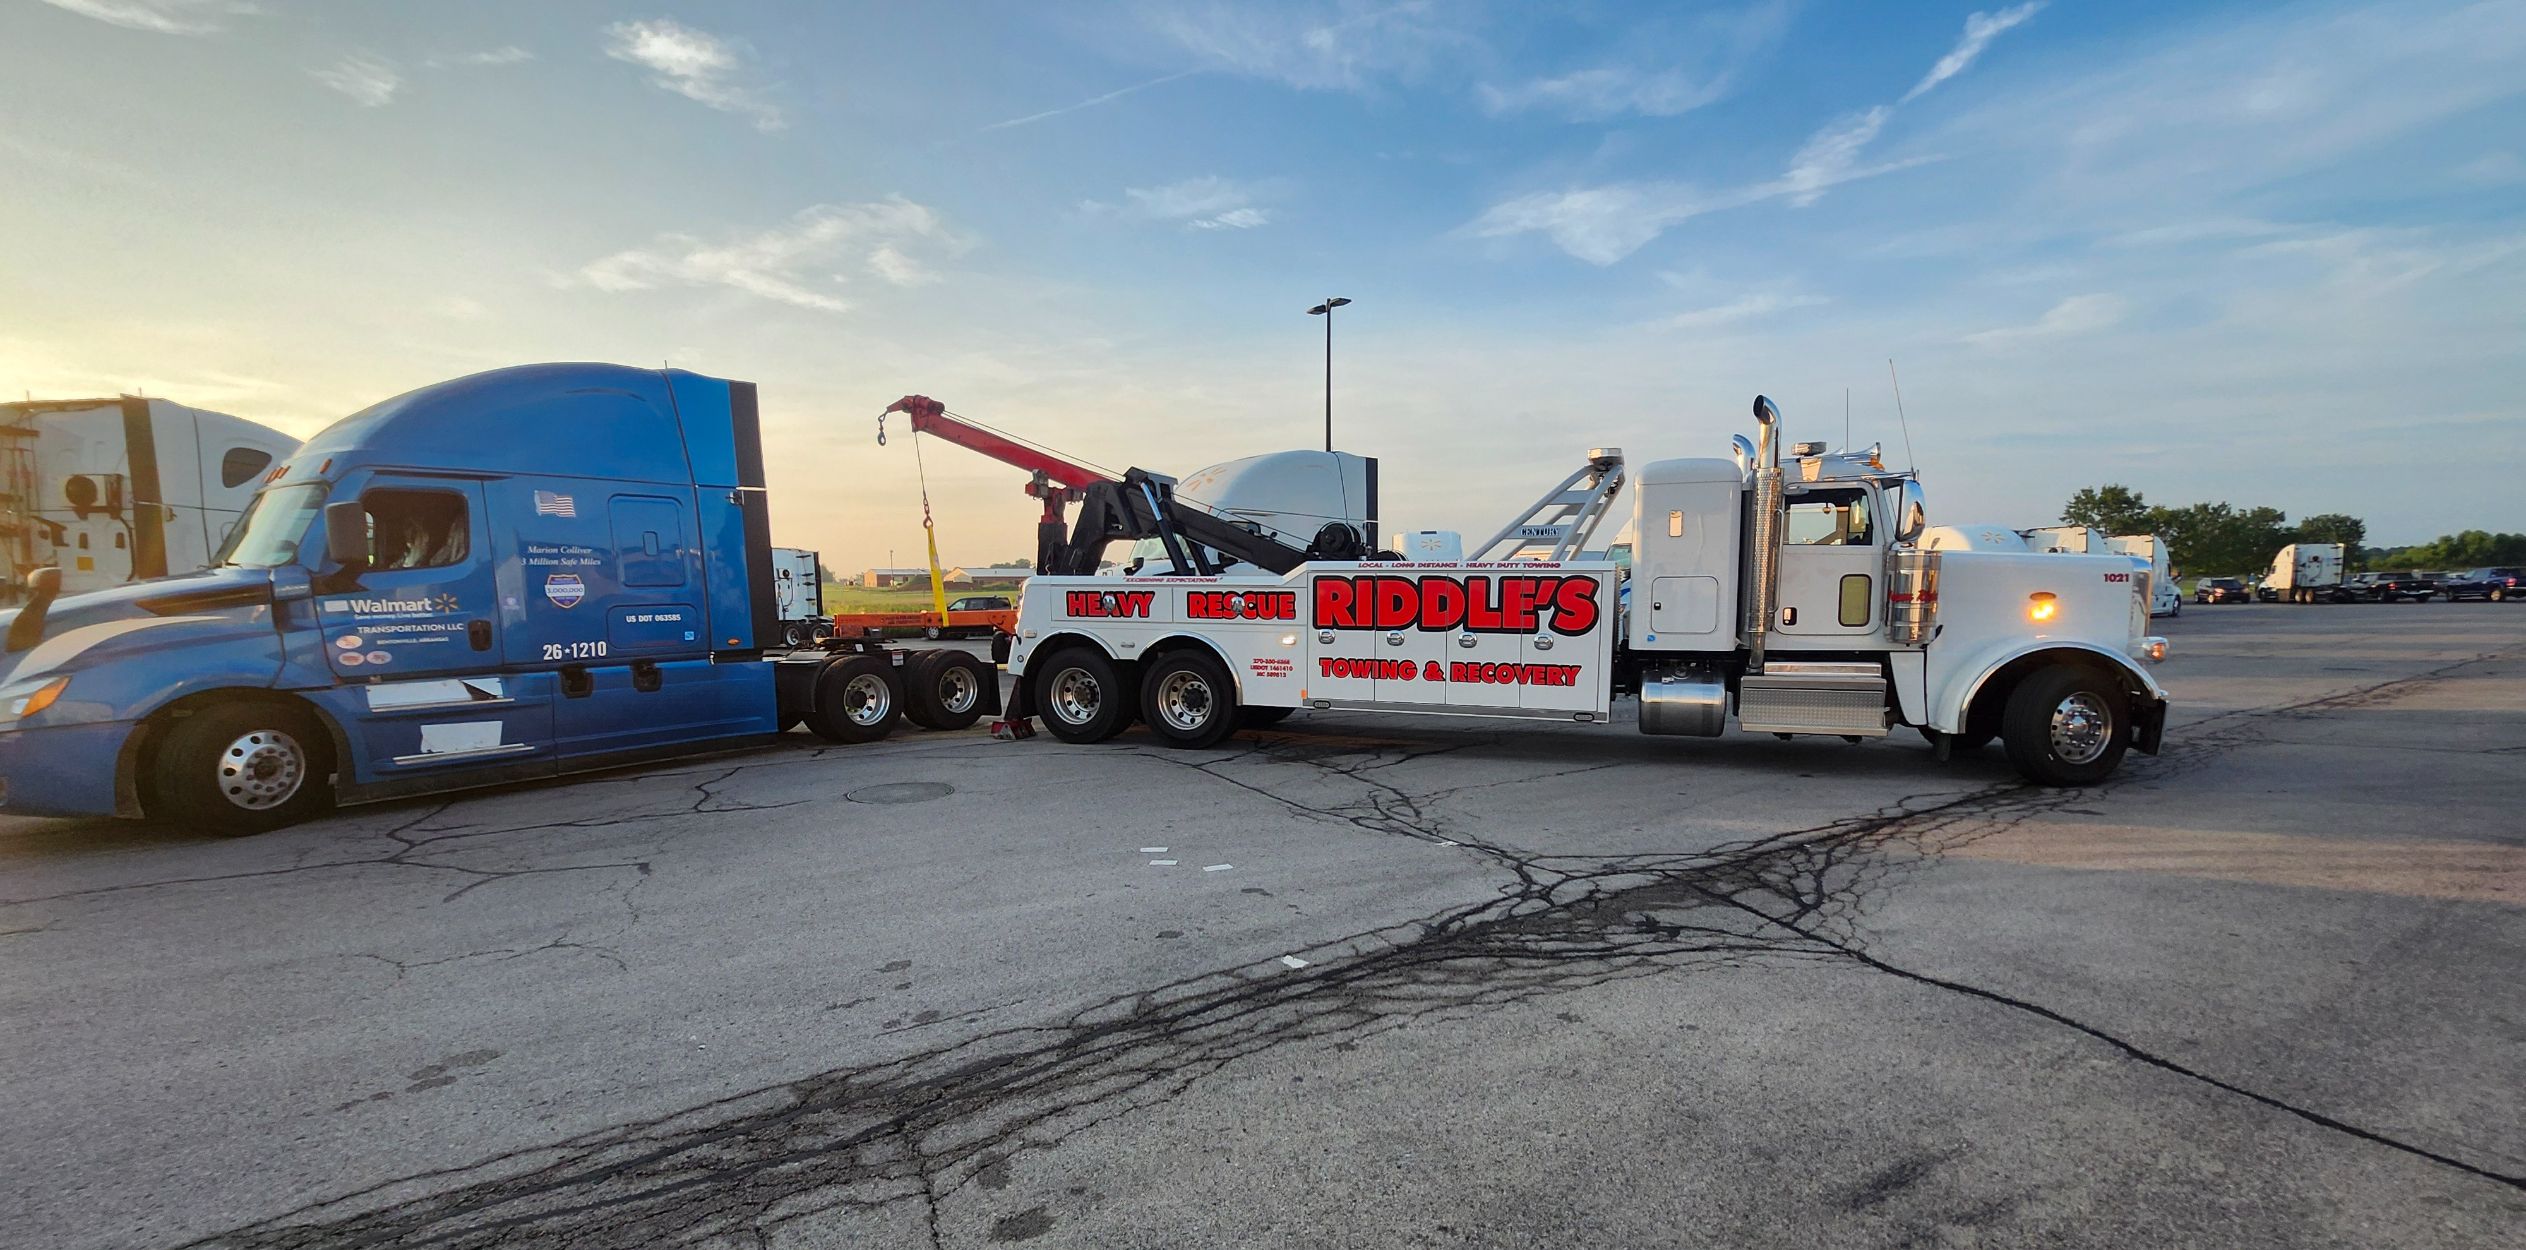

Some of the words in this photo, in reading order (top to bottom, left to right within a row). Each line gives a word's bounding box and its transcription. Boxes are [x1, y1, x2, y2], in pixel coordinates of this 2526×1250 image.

[1521, 528, 1560, 536] CENTURY
[528, 546, 558, 554] Marion
[560, 558, 577, 566] Safe
[2104, 573, 2129, 582] 1021
[350, 598, 432, 613] Walmart
[1187, 591, 1296, 620] RESCUE
[1313, 575, 1600, 636] RIDDLE'S
[626, 615, 636, 623] US
[638, 614, 652, 622] DOT
[357, 624, 445, 634] TRANSPORTATION
[447, 622, 464, 631] LLC
[1319, 657, 1417, 680] TOWING
[1423, 660, 1445, 682] &
[1450, 662, 1581, 686] RECOVERY
